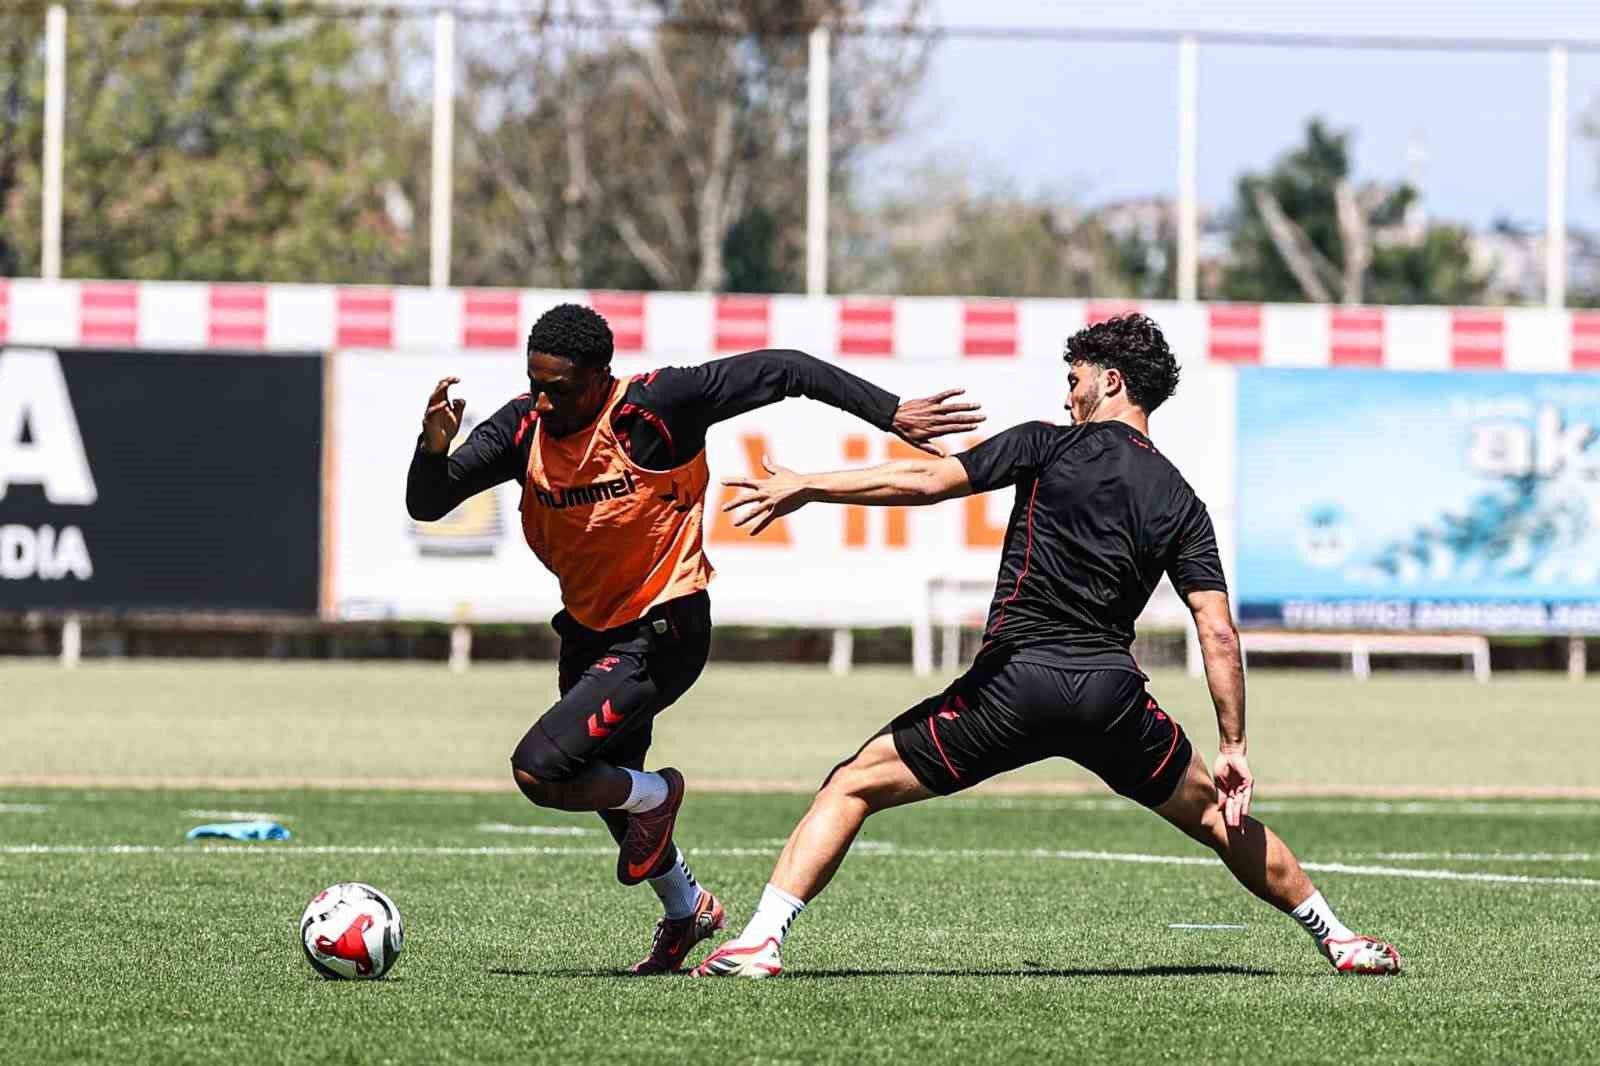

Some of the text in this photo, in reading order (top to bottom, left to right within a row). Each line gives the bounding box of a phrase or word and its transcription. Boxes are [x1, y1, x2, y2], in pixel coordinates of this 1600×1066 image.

[0, 349, 97, 504] A
[534, 470, 636, 510] hummel
[0, 523, 94, 580] DIA
